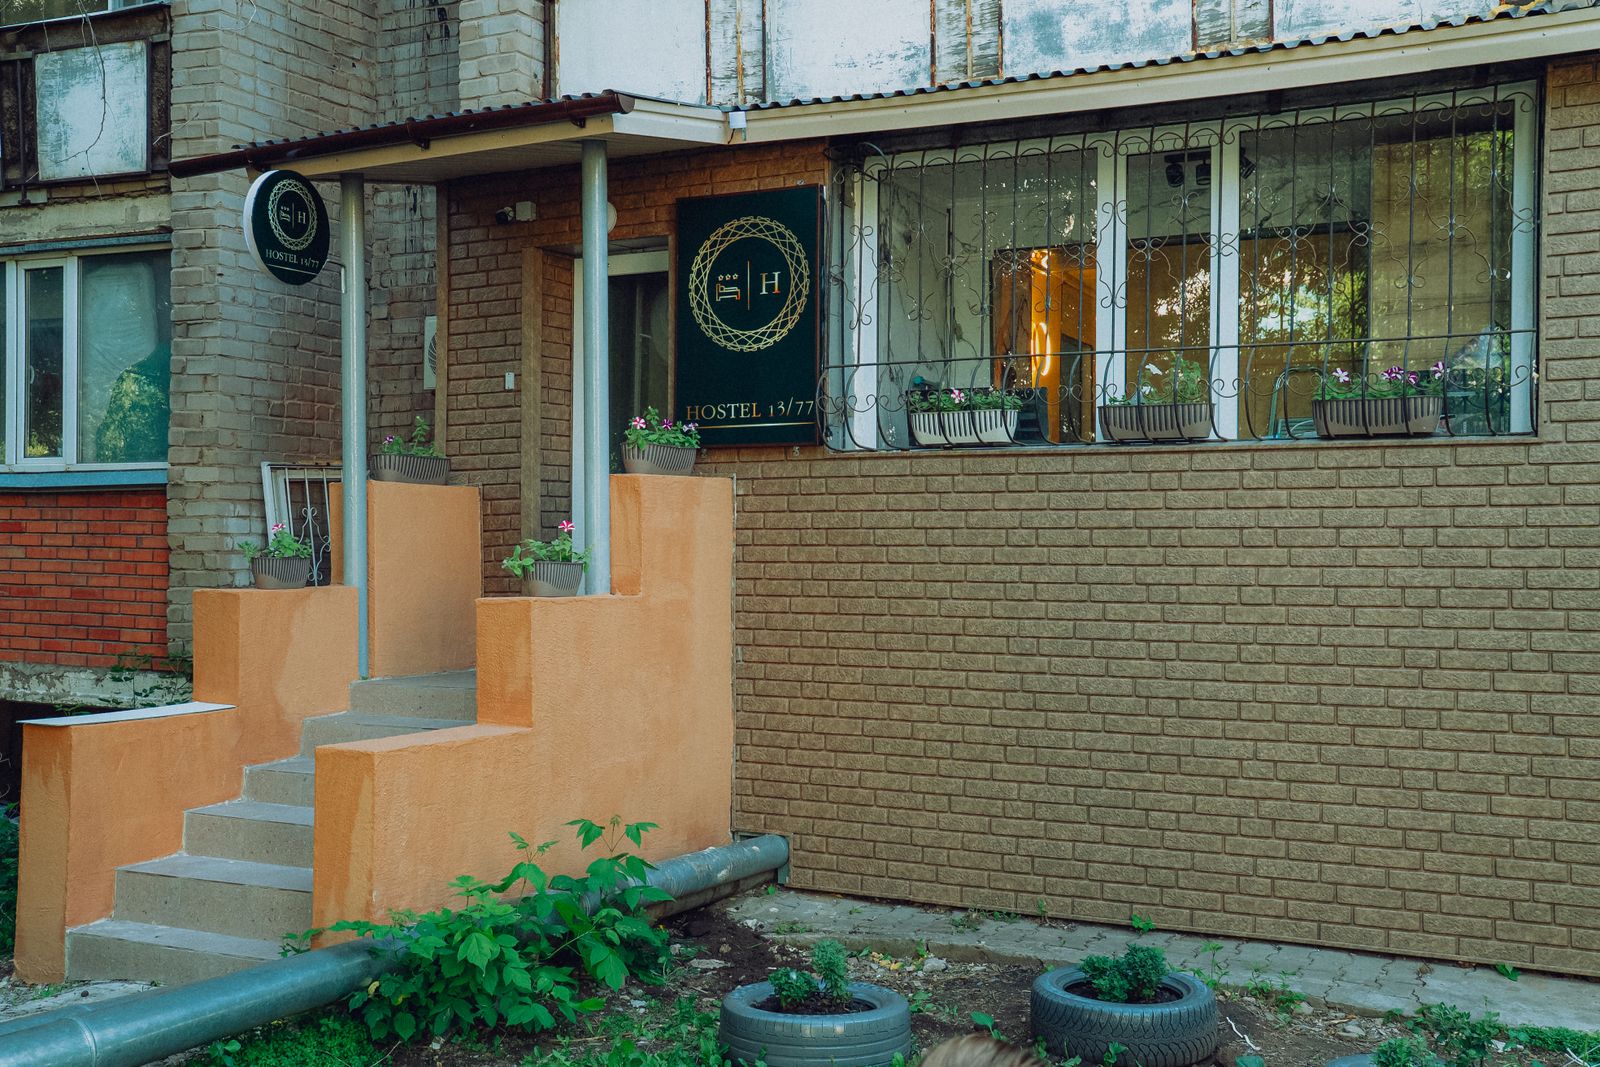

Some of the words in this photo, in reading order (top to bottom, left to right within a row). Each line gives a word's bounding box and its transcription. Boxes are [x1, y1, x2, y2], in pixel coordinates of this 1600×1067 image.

[297, 210, 307, 225] H
[265, 248, 299, 264] HOSTEL
[300, 257, 320, 268] 13/77
[759, 271, 781, 295] H
[686, 402, 762, 420] HOSTEL
[768, 396, 814, 417] 13/77
